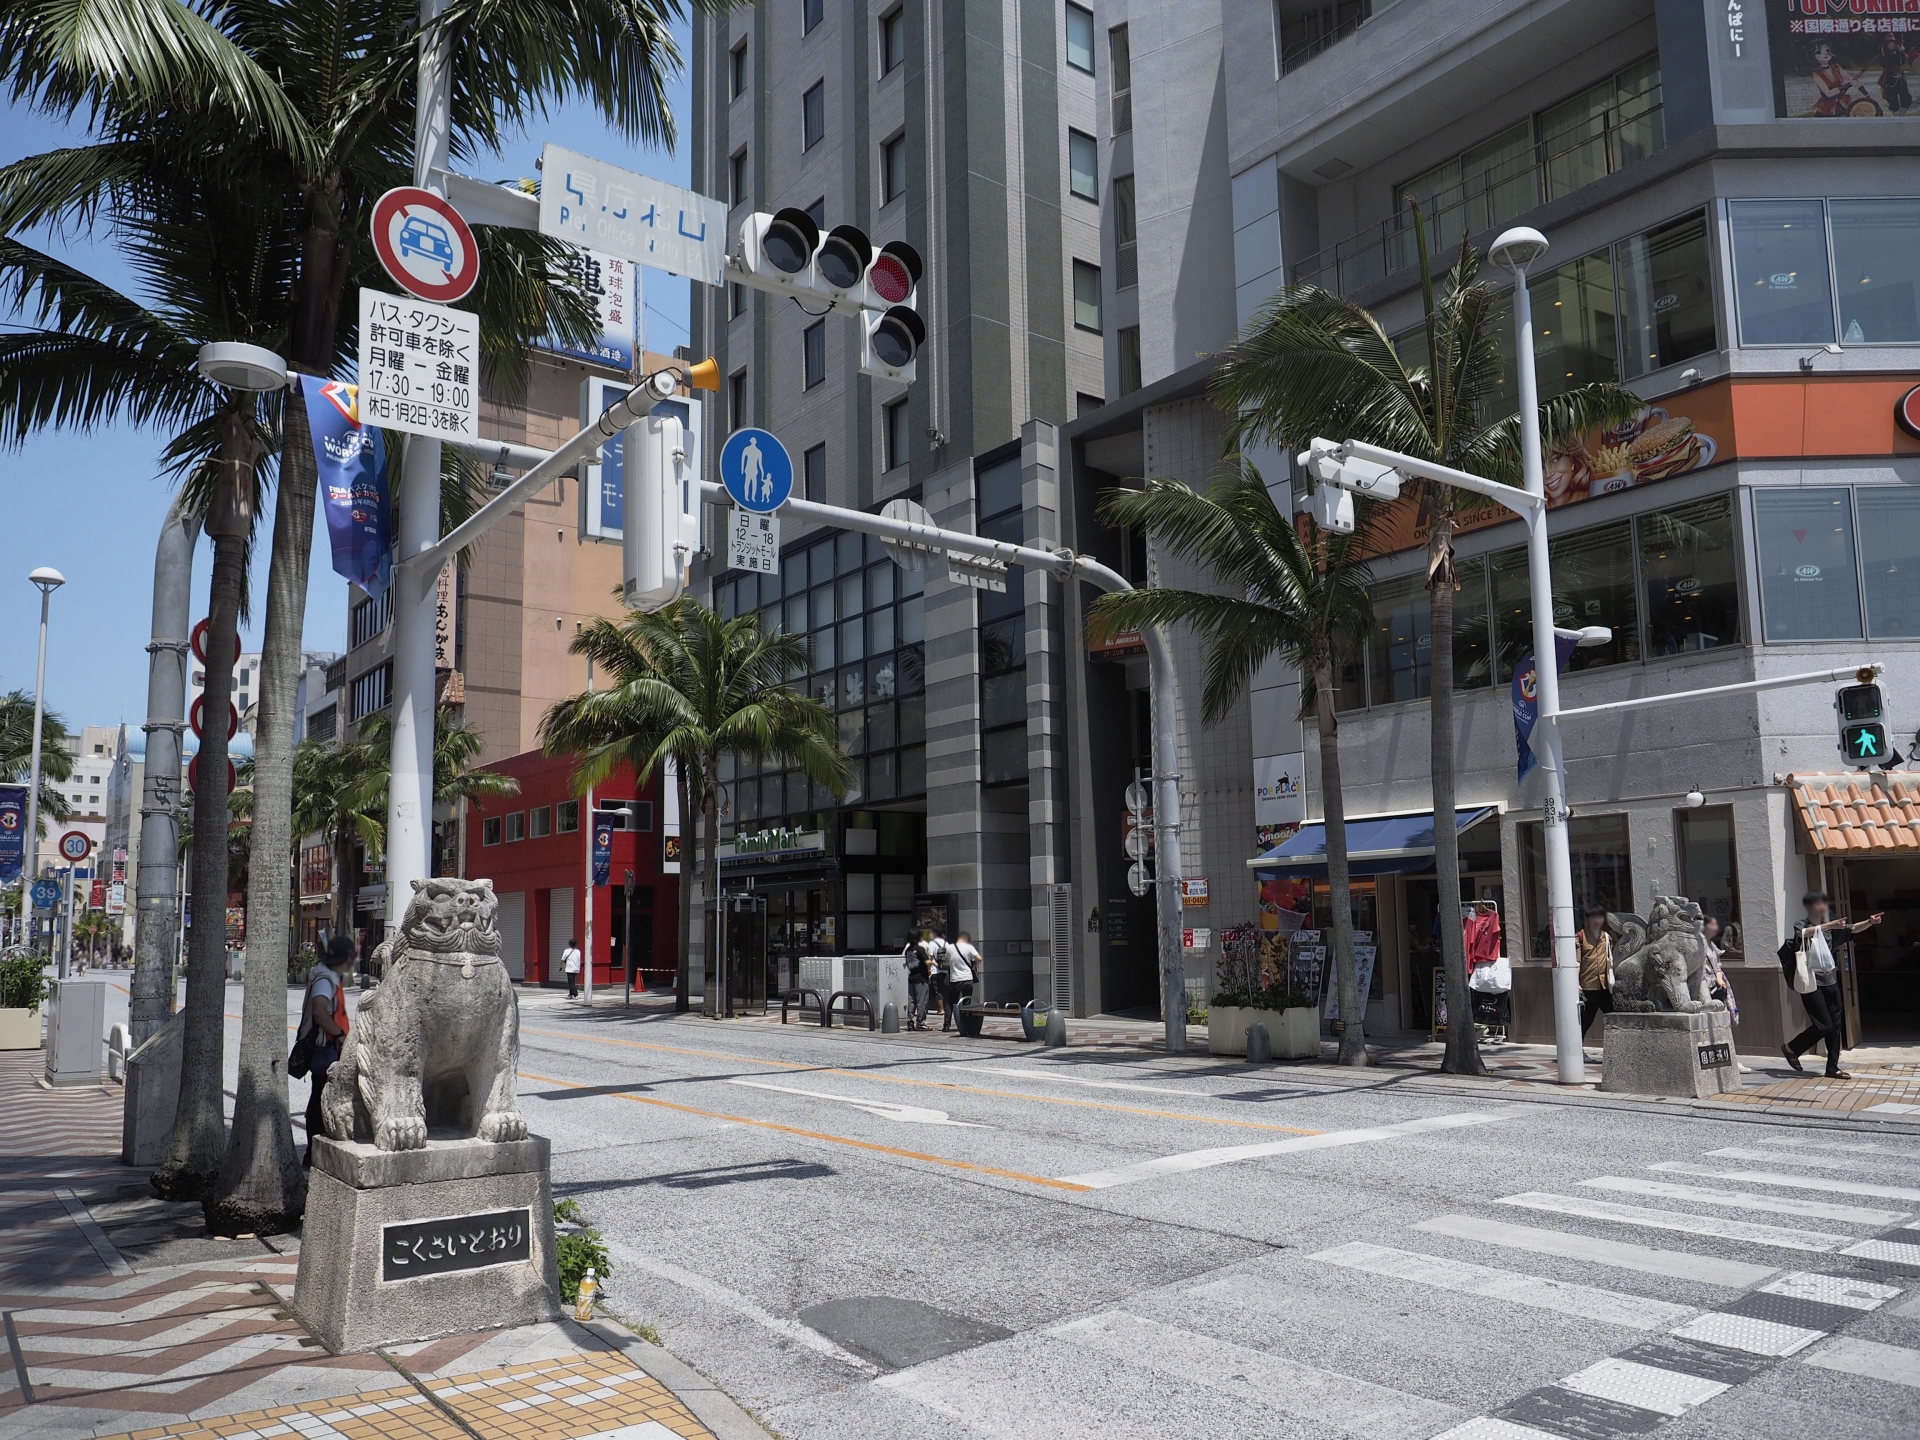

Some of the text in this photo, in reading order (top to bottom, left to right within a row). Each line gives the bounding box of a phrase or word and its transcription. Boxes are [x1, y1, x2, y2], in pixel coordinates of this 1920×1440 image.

[607, 258, 625, 326] 琉球泡盛
[370, 300, 470, 336] バス・タクシー
[370, 322, 470, 363] 許可車を除く
[369, 346, 405, 372] 月曜
[436, 361, 470, 386] 金曜
[369, 370, 409, 397] 17:30
[431, 382, 470, 409] 19:00
[368, 396, 469, 434] 休日・1月2日・3を除く
[1463, 510, 1493, 527] SINCE
[735, 527, 746, 541] 12
[763, 532, 774, 545] 18
[731, 540, 776, 559] トランジットモール
[736, 554, 771, 571] 実施日
[1115, 635, 1139, 645] AMERICAN
[1257, 783, 1302, 796] POP PLACE
[1544, 797, 1555, 807] 39
[1544, 806, 1556, 816] R3
[1545, 816, 1555, 825] P1
[66, 839, 85, 854] 30
[735, 827, 802, 854] FamilyMart
[36, 887, 56, 899] 39
[1700, 1048, 1729, 1065] 国際通り
[392, 1224, 521, 1265] こくさいとおり
